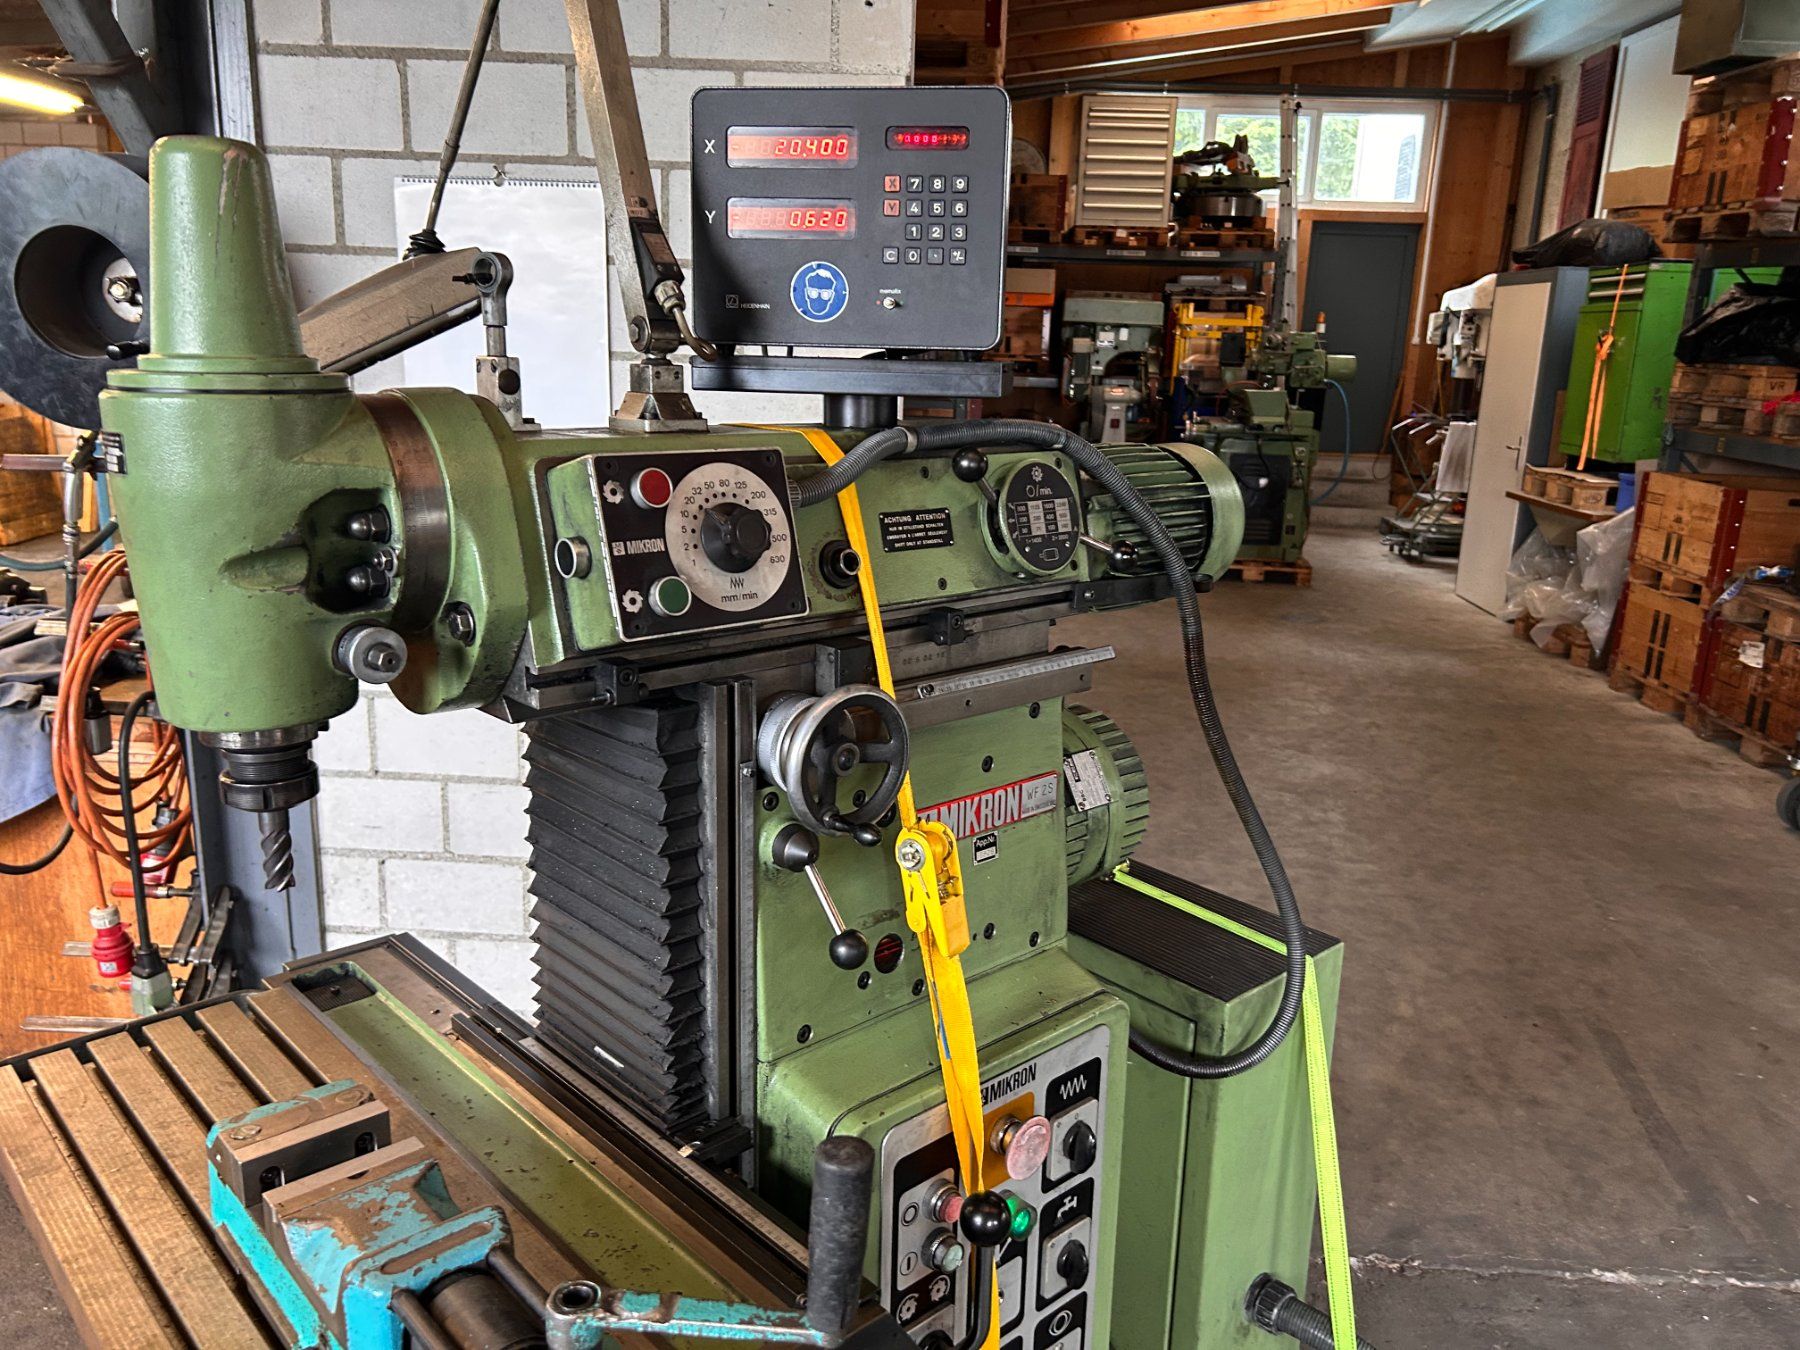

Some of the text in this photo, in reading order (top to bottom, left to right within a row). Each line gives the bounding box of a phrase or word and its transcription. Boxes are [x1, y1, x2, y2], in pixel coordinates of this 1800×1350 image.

[704, 140, 715, 154] X
[910, 179, 965, 188] 7 8 9
[910, 204, 964, 213] 4 5 6
[705, 210, 716, 224] Y
[932, 228, 940, 237] 2
[955, 228, 964, 237] 3
[886, 251, 895, 260] C
[704, 482, 715, 490] 50
[719, 479, 730, 488] 80
[734, 481, 748, 489] 125
[692, 487, 702, 496] 32
[752, 491, 766, 499] 200
[684, 496, 696, 505] 20
[680, 510, 689, 518] 10
[764, 508, 777, 516] 315
[884, 512, 946, 524] ACHTUNG ATTENTION
[682, 526, 688, 534] 5
[772, 534, 788, 542] 500
[626, 538, 666, 554] MIKRON
[770, 554, 786, 564] 630
[721, 592, 758, 603] mm/min
[941, 785, 1020, 838] MIKRON
[990, 1062, 1036, 1102] MIKRON
